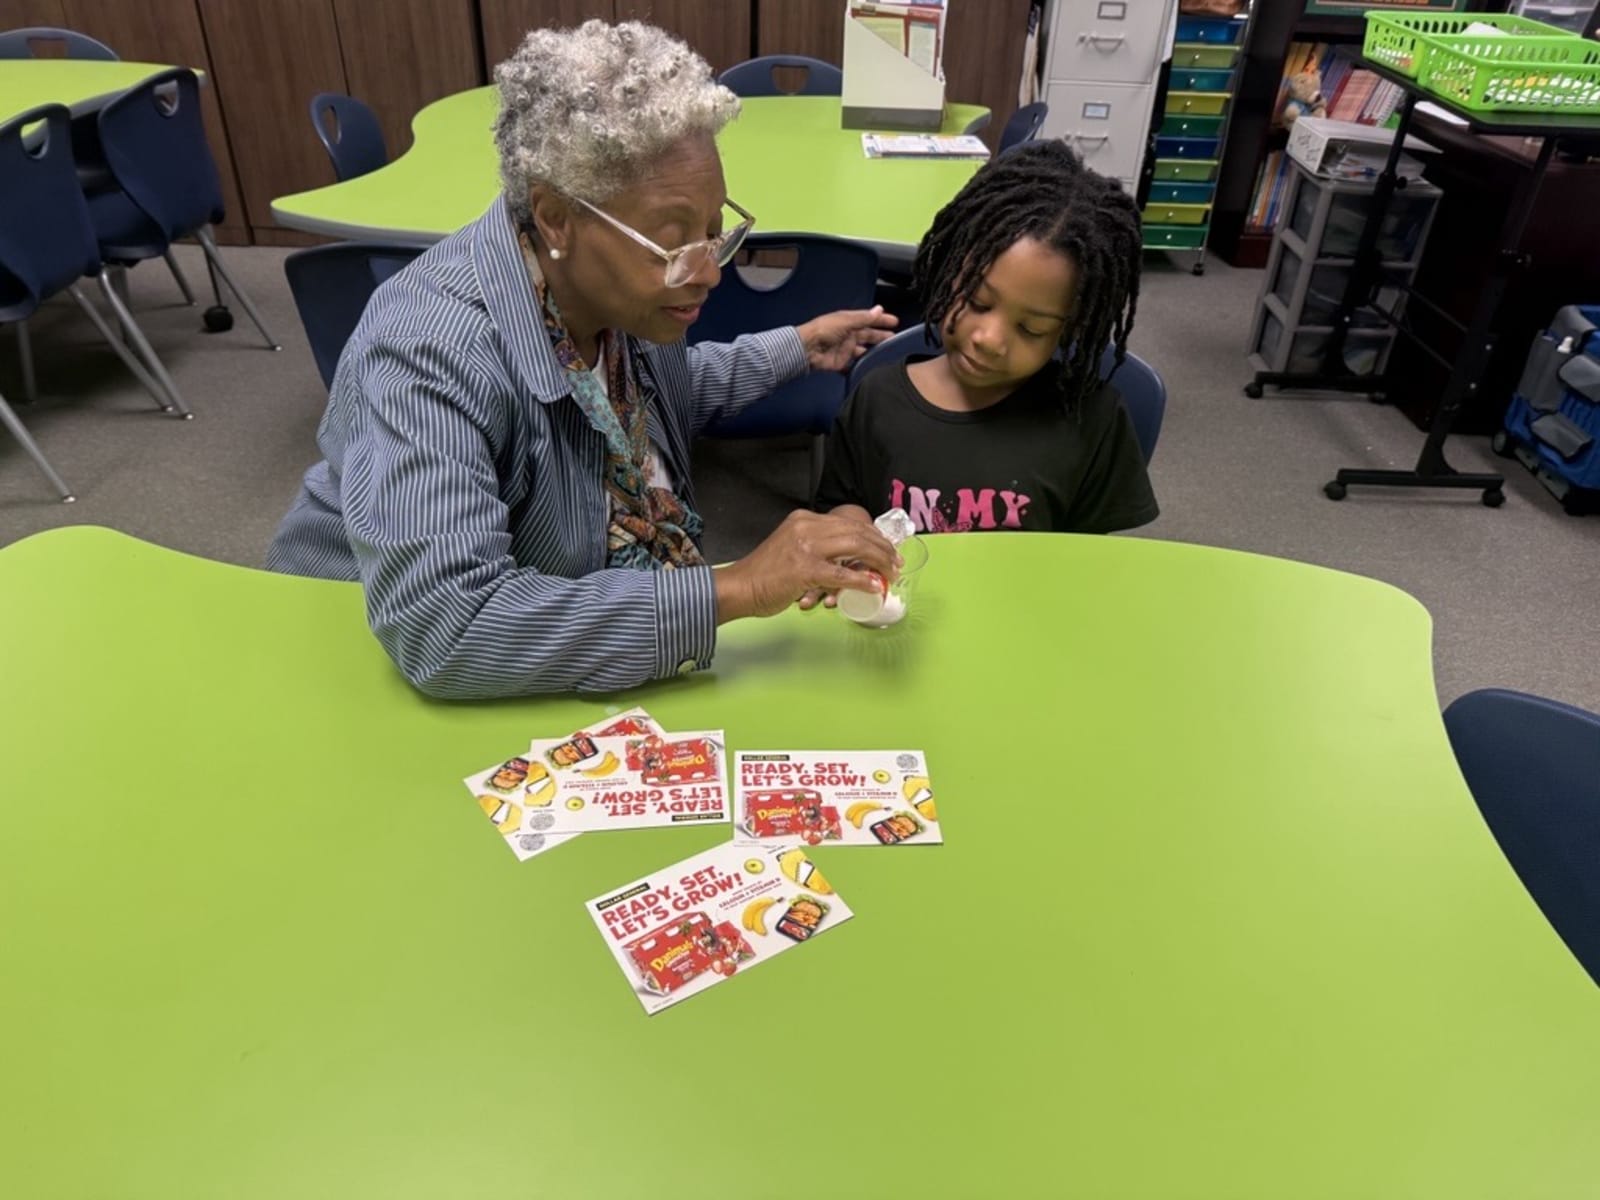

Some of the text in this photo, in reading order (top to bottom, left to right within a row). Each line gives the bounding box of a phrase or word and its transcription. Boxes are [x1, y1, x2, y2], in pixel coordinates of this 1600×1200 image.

[889, 478, 941, 532] IN
[957, 488, 1031, 529] MY
[741, 763, 853, 774] READY. SET.
[741, 775, 867, 787] LET'S GROW!
[592, 786, 723, 805] LET'S GROW!
[604, 799, 723, 817] READY. SET.
[602, 884, 678, 926] READY.
[680, 866, 723, 892] SET.
[610, 905, 669, 941] LET'S
[672, 873, 744, 912] GROW!
